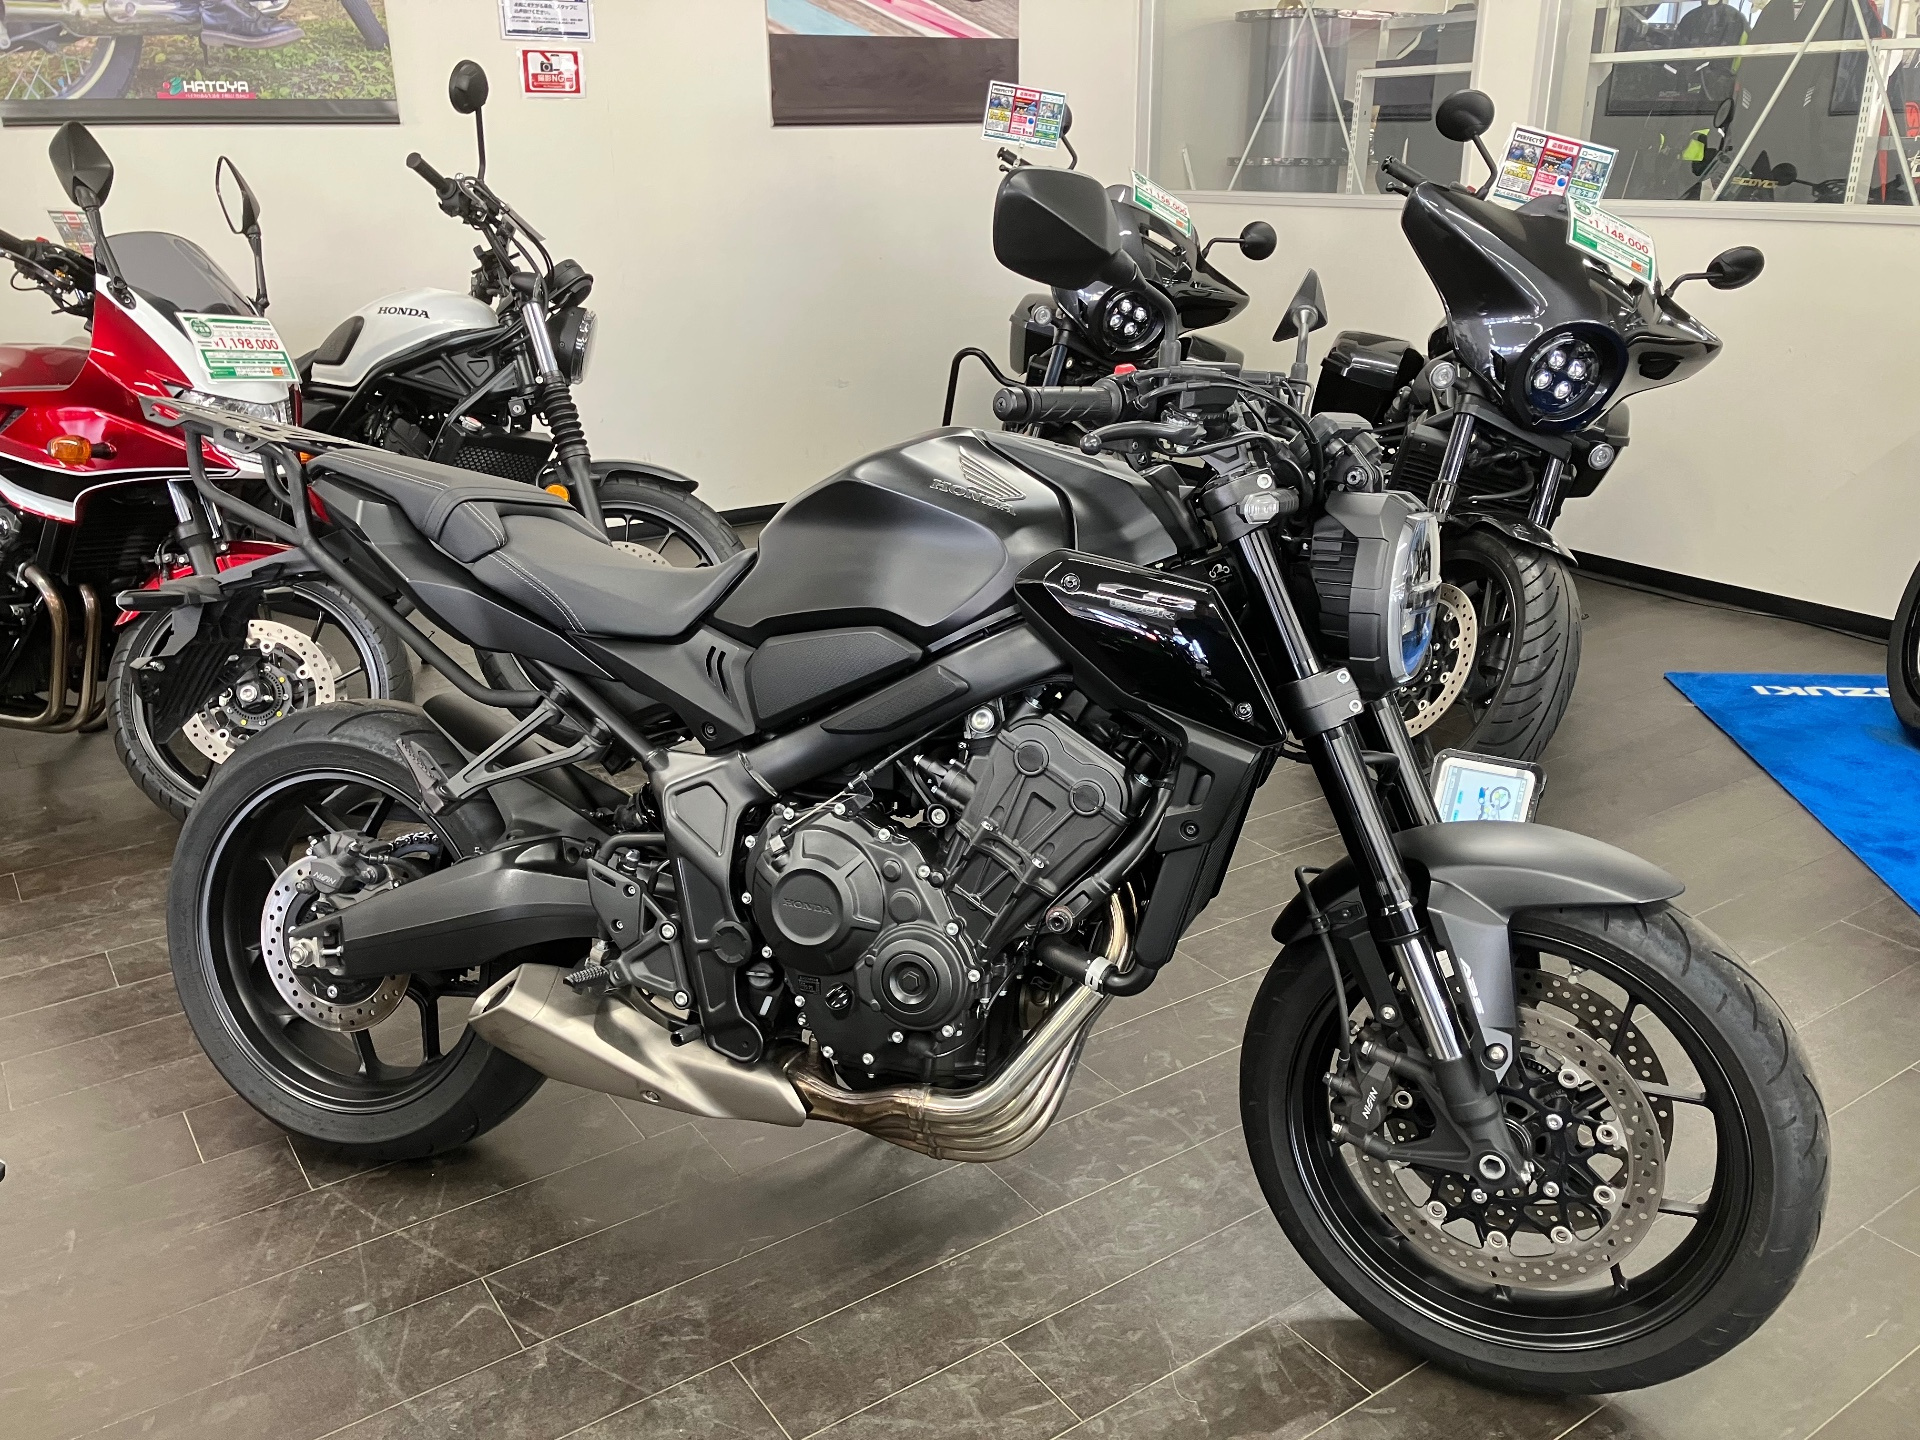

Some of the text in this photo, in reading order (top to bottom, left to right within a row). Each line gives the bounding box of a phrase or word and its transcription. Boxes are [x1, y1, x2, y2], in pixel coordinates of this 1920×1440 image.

[183, 80, 249, 93] HATOYA
[1588, 219, 1649, 254] ¥1,148,000
[377, 306, 431, 320] HONDA
[213, 337, 279, 351] ¥1,198,000
[930, 478, 1017, 516] HONDA
[782, 897, 833, 915] HONDA
